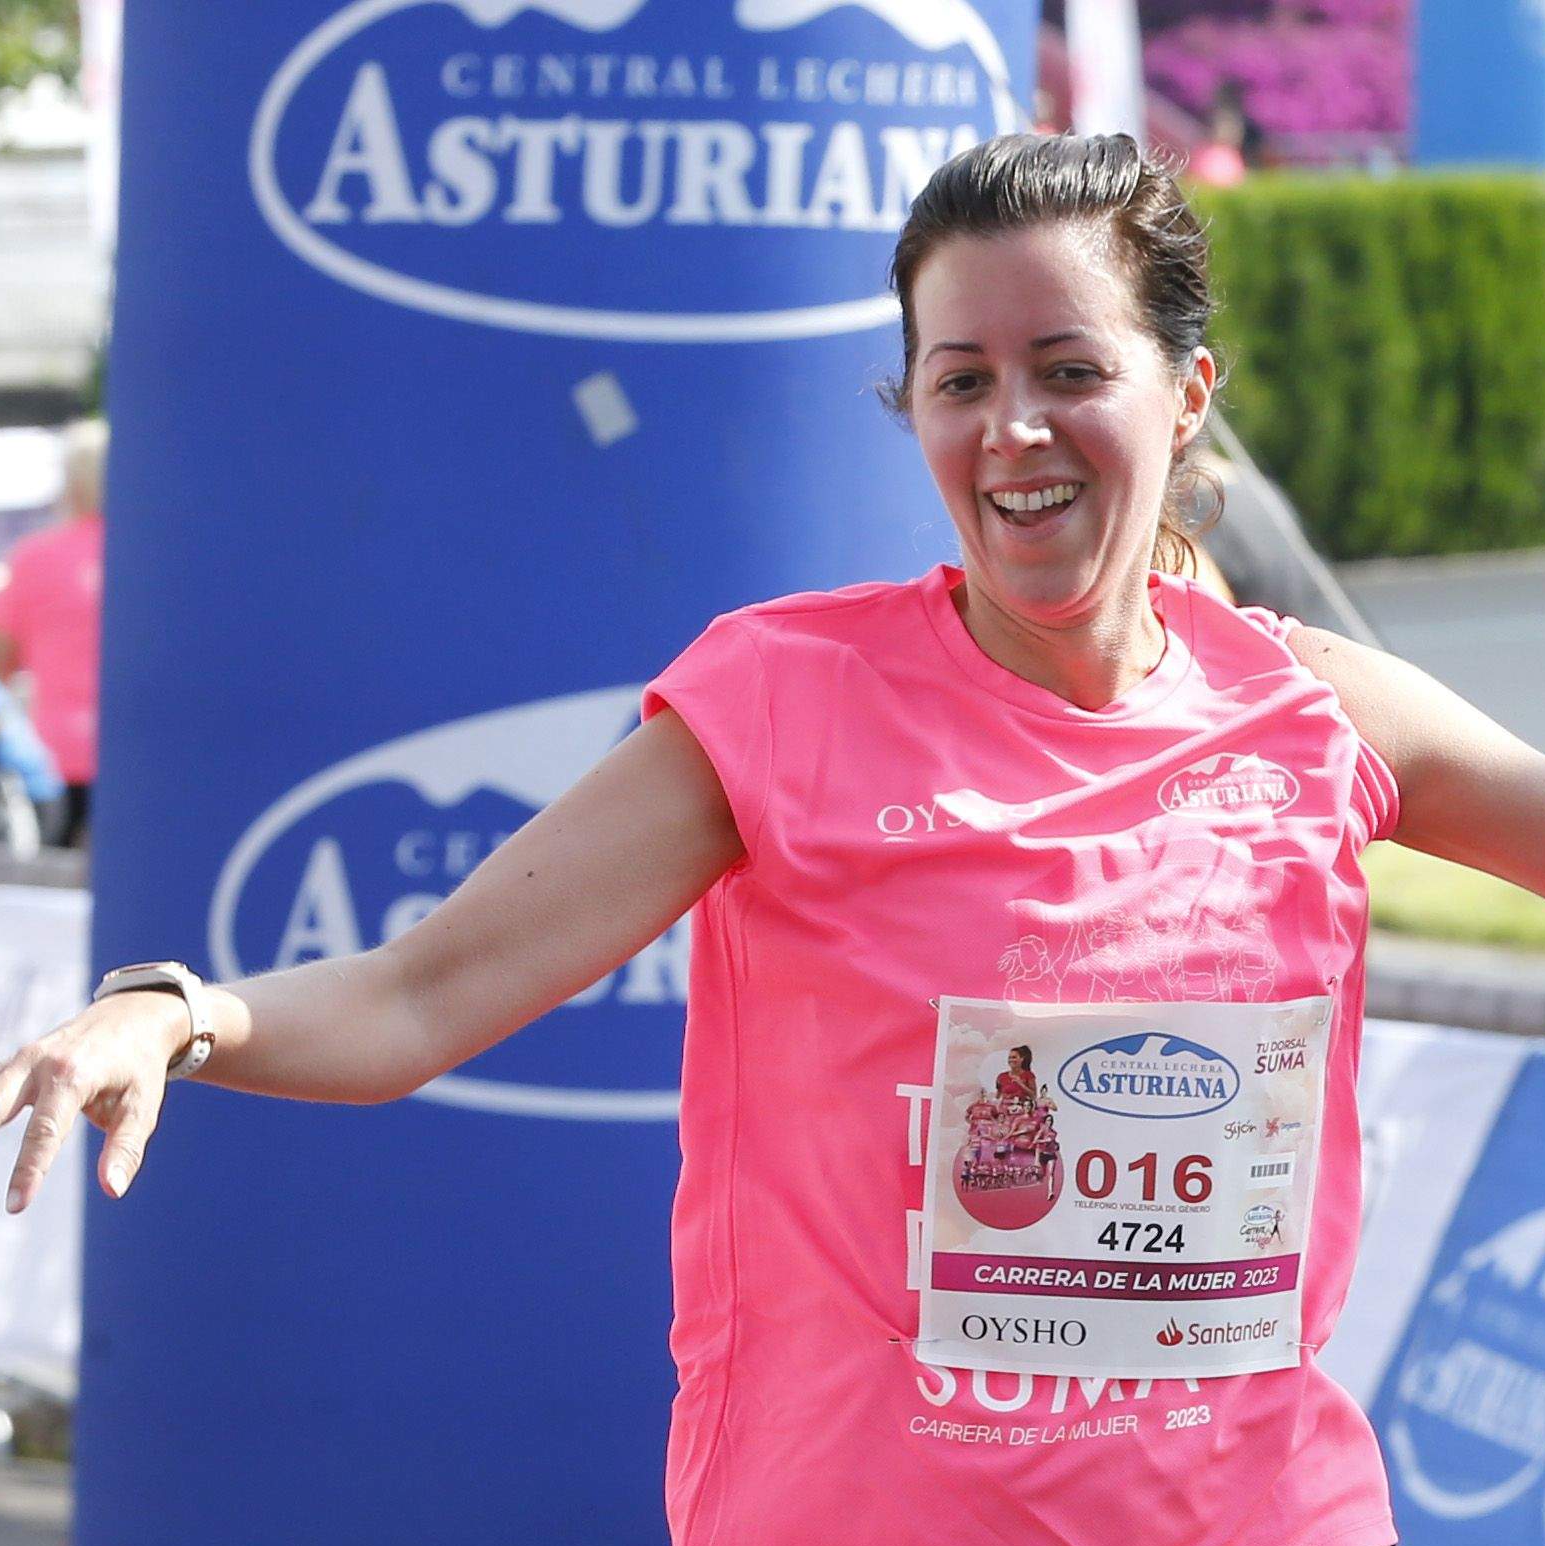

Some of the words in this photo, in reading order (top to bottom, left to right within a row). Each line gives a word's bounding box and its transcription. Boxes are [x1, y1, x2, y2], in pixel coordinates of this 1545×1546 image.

[440, 52, 736, 100] CENTRAL
[1168, 780, 1292, 809] ASTURIANA
[1255, 1042, 1270, 1054] TU
[1270, 1037, 1308, 1052] DORSAL
[1100, 1060, 1159, 1072] CENTRAL
[1164, 1061, 1224, 1073] LECHERA
[1254, 1051, 1306, 1075] SUMA
[1070, 1062, 1228, 1099] ASTURIANA
[1074, 1149, 1214, 1204] 016
[1165, 1204, 1177, 1213] DE
[1097, 1221, 1186, 1254] 4724
[973, 1264, 1088, 1289] CARRERA
[1093, 1270, 1127, 1291] DE
[1132, 1271, 1162, 1292] LA
[1167, 1269, 1238, 1292] MUJER
[1241, 1265, 1280, 1288] 2023
[961, 1313, 1087, 1347] OYSHO
[1186, 1317, 1279, 1346] Santander
[908, 1415, 1004, 1446] CARRERA
[1007, 1425, 1041, 1447] DE
[1067, 1413, 1139, 1443] MUJER
[1163, 1403, 1213, 1432] 2023
